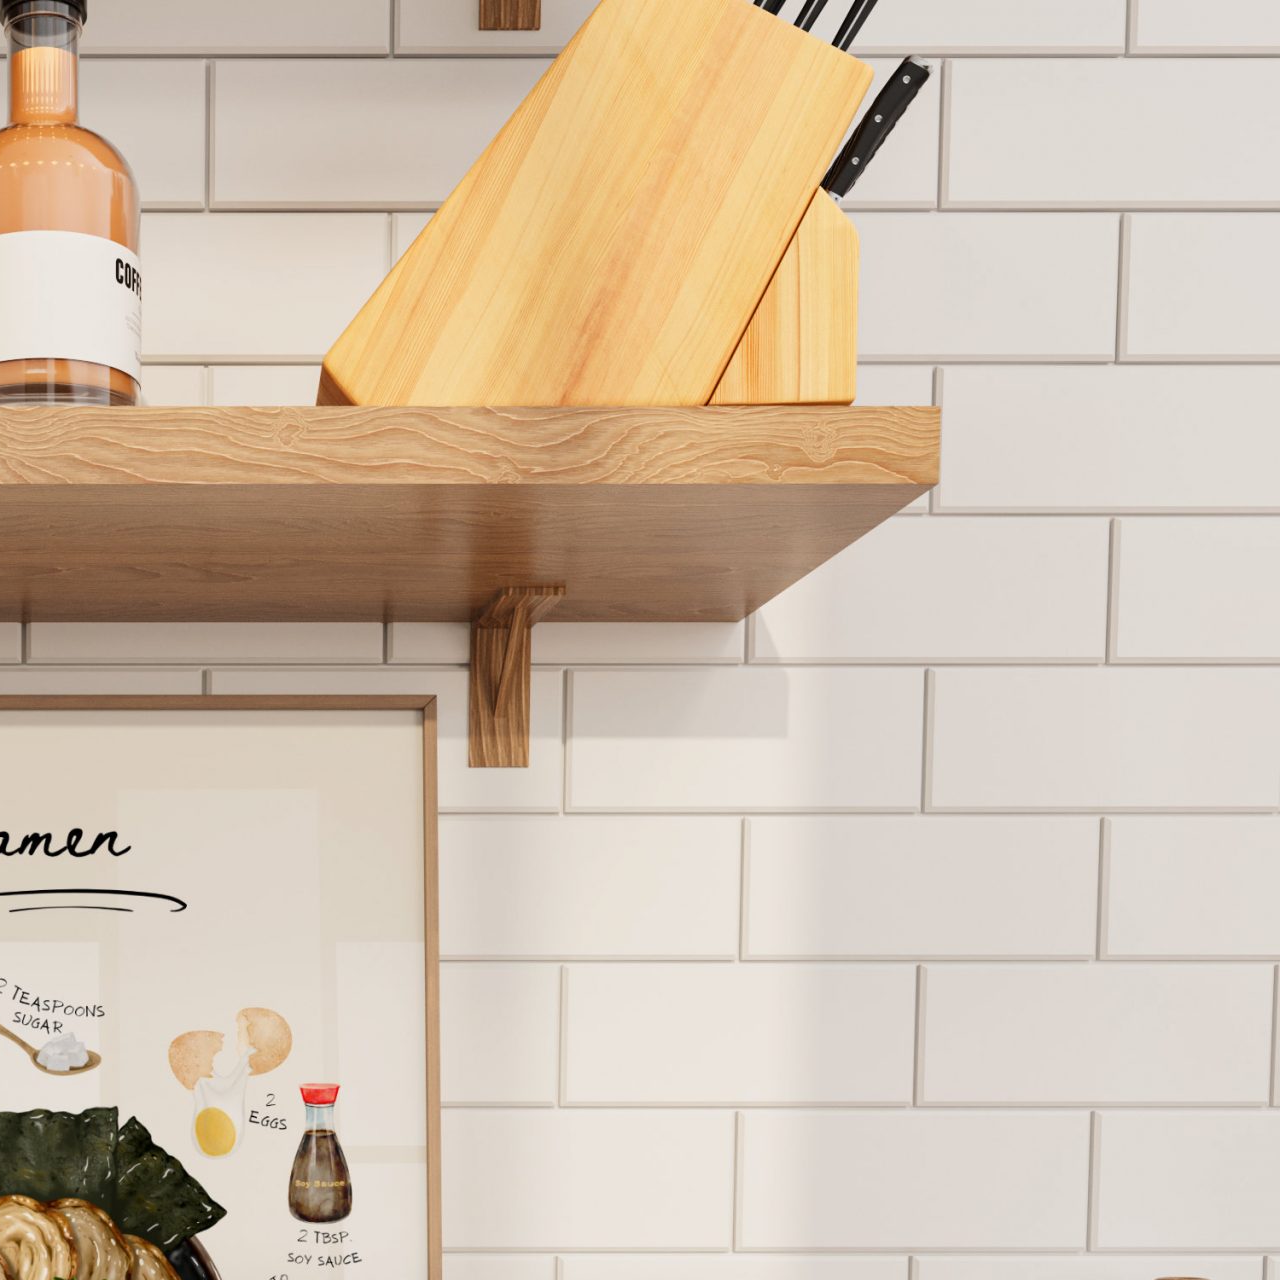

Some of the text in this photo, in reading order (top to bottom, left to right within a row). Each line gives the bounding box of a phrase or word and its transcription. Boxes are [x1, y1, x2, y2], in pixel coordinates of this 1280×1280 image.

[115, 257, 142, 303] COFF
[12, 984, 106, 1018] TEASPOONS
[12, 1011, 64, 1035] SUGAR
[265, 1093, 277, 1107] 2
[248, 1110, 288, 1131] EGGS
[297, 1229, 308, 1243] 2
[287, 1251, 362, 1269] SOY SAUCE
